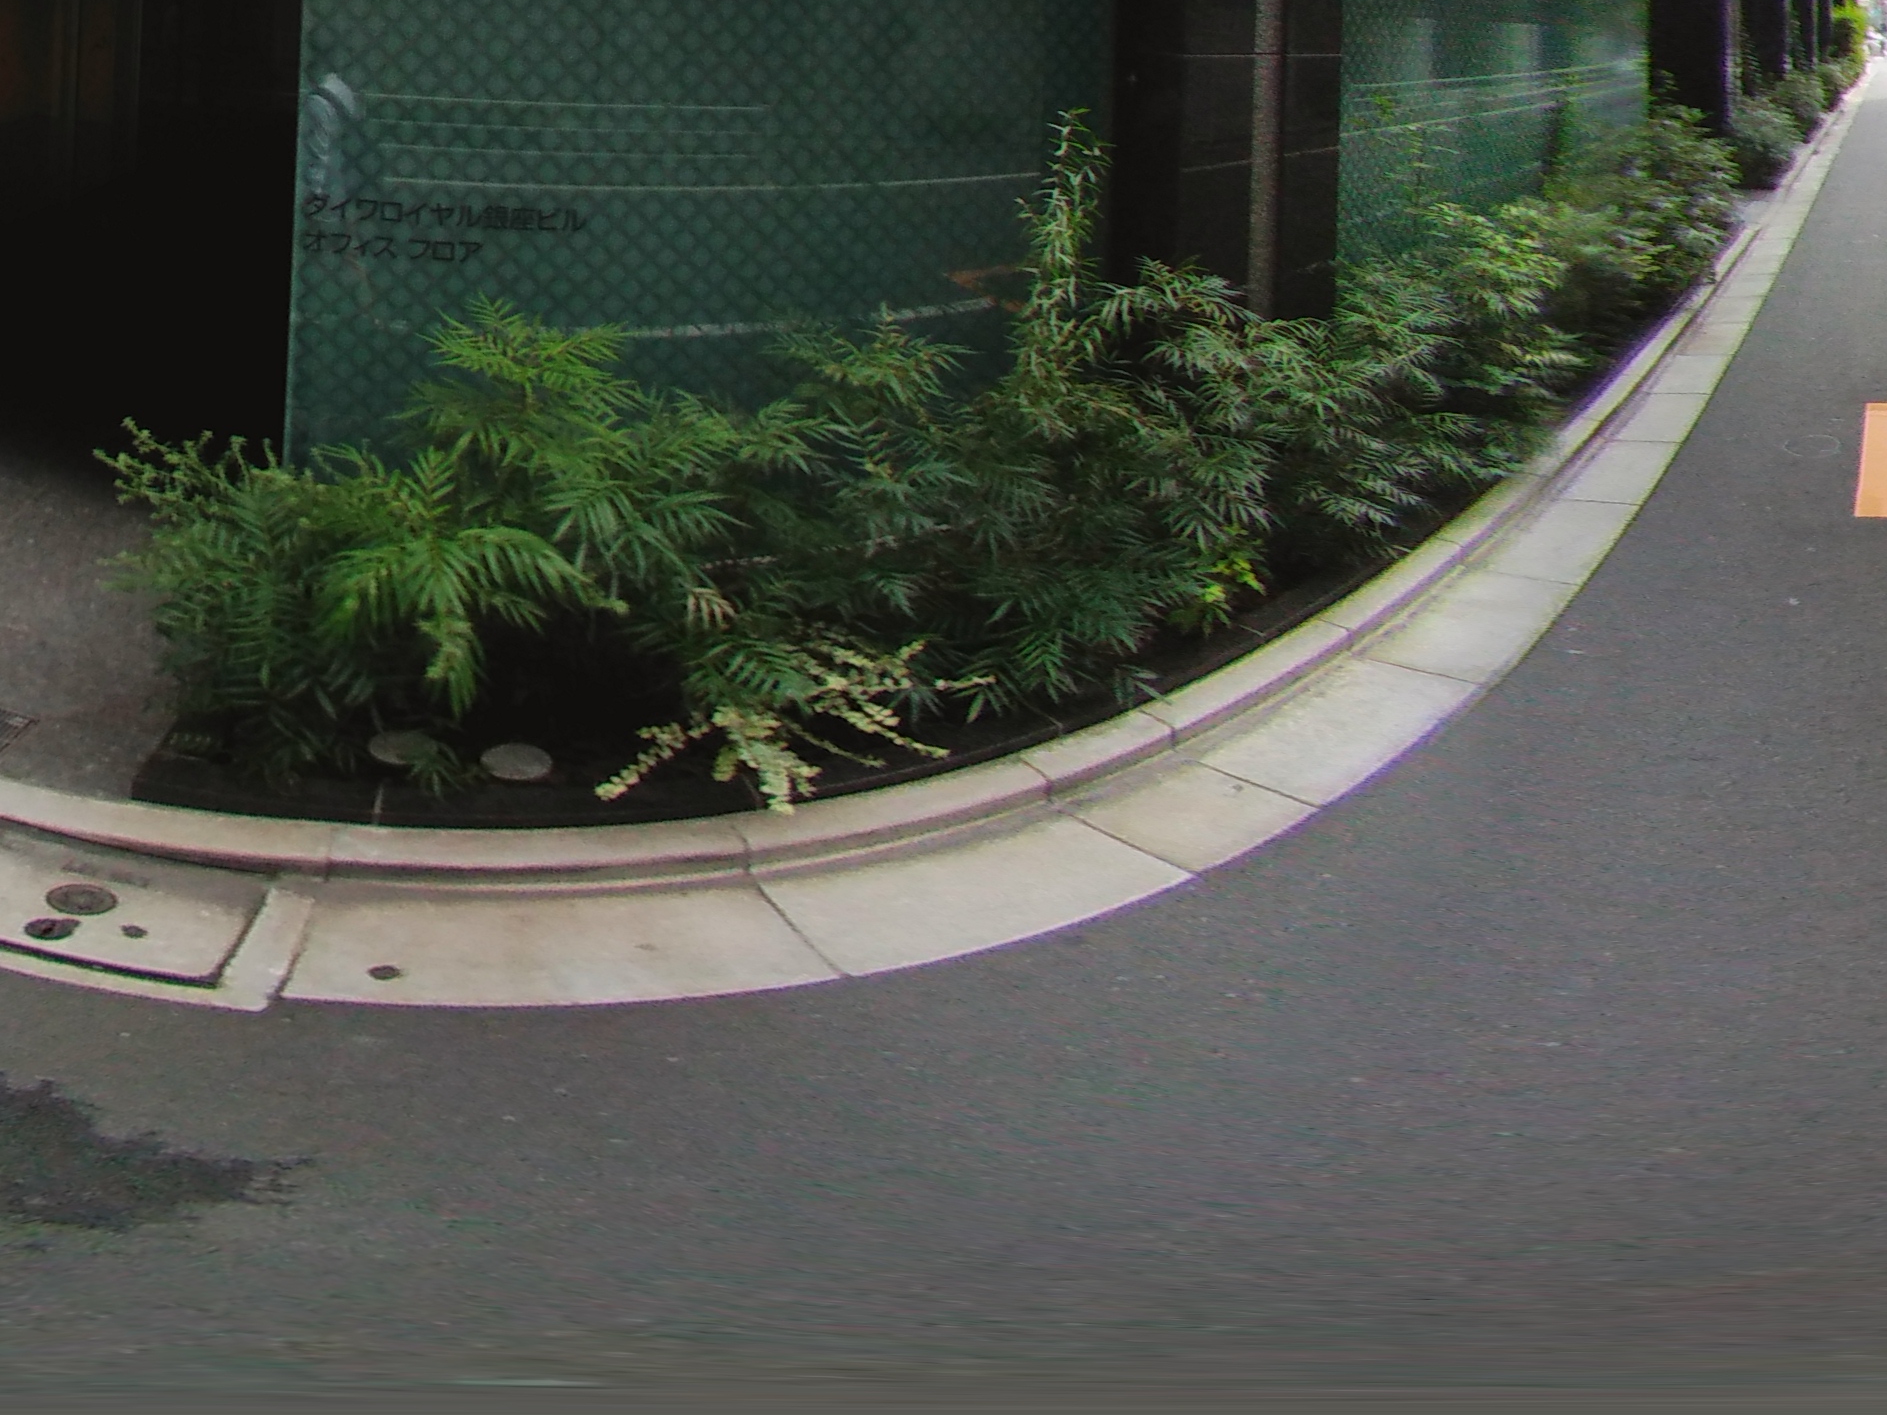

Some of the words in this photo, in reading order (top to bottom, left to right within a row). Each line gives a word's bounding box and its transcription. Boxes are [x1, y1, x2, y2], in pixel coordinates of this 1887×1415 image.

[302, 193, 587, 232] ダイワロイヤル銀座ビル
